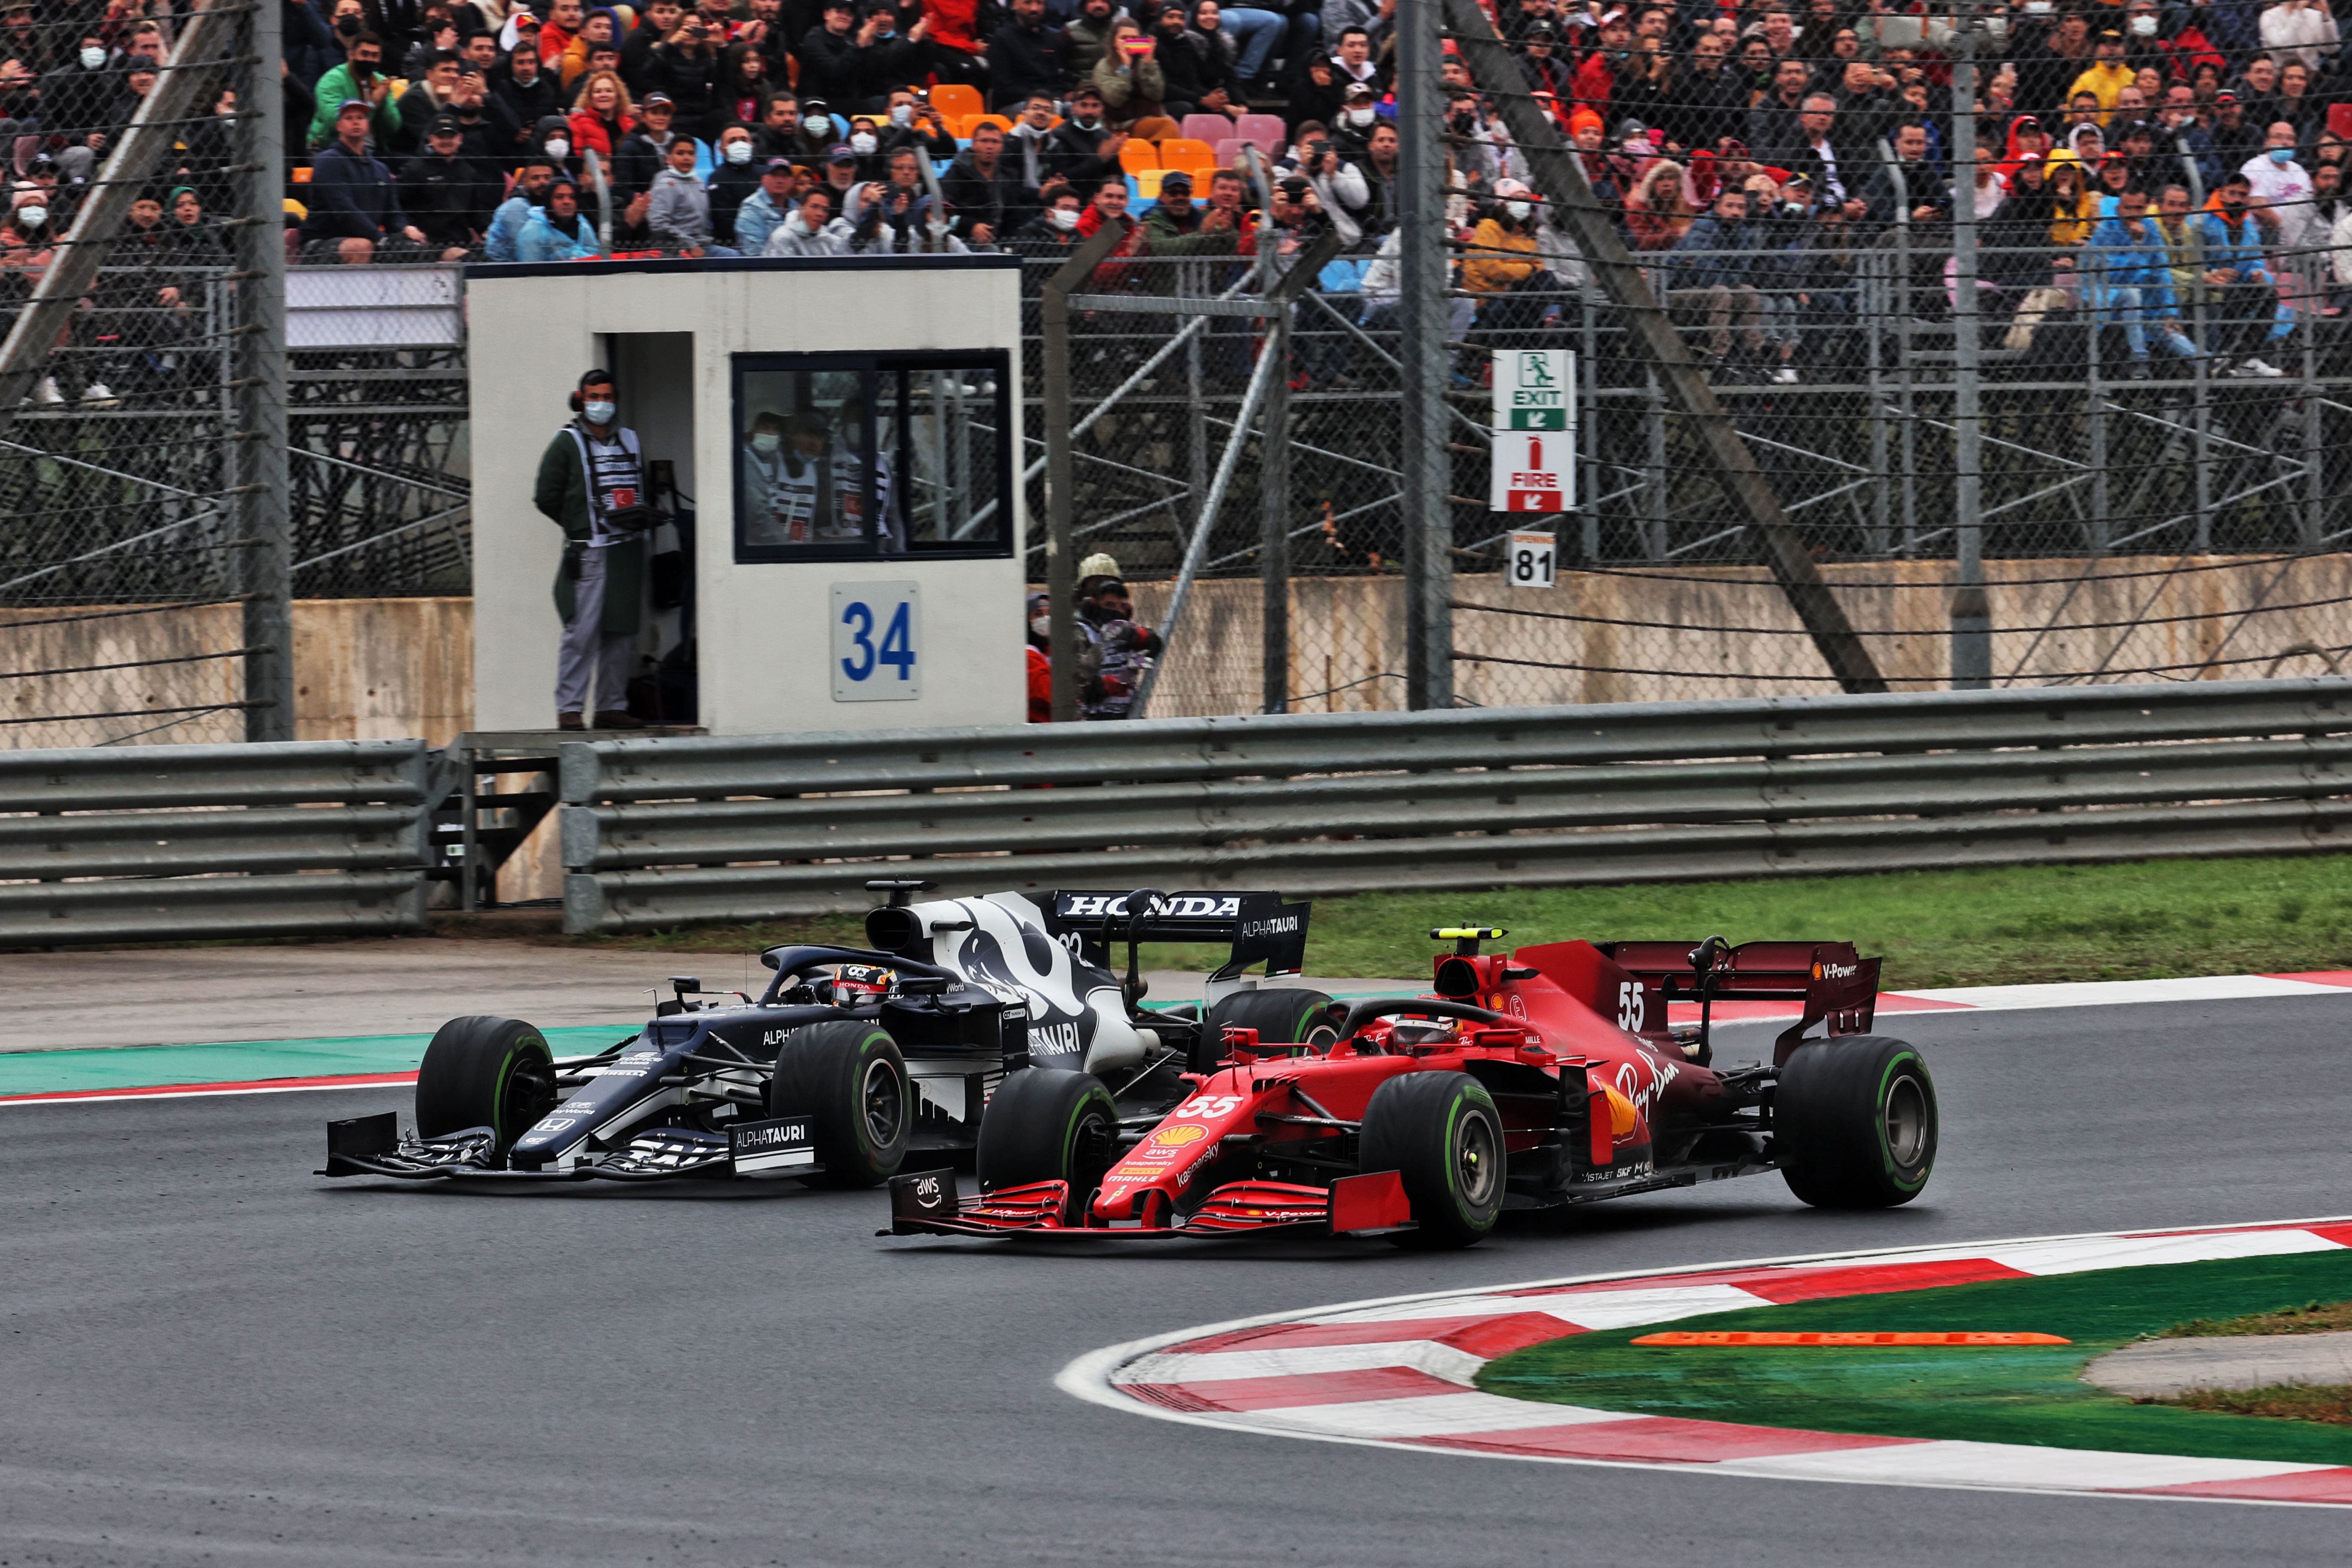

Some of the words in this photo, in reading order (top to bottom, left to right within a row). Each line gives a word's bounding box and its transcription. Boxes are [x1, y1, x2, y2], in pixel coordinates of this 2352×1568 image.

[1513, 391, 1561, 405] EXIT
[1511, 472, 1558, 487] FIRE
[1516, 550, 1551, 582] 81
[841, 602, 916, 681] 34
[1242, 915, 1298, 937] ALPHATAURI
[1822, 963, 1857, 980] V-Power
[946, 982, 965, 995] yWorld
[1618, 982, 1644, 1032] 55
[1525, 1035, 1540, 1044] MILLE
[1176, 1096, 1244, 1118] 55
[736, 1124, 805, 1148] ALPHATAURI
[1176, 1142, 1219, 1188] kaspersky
[1617, 1166, 1632, 1178] SKF
